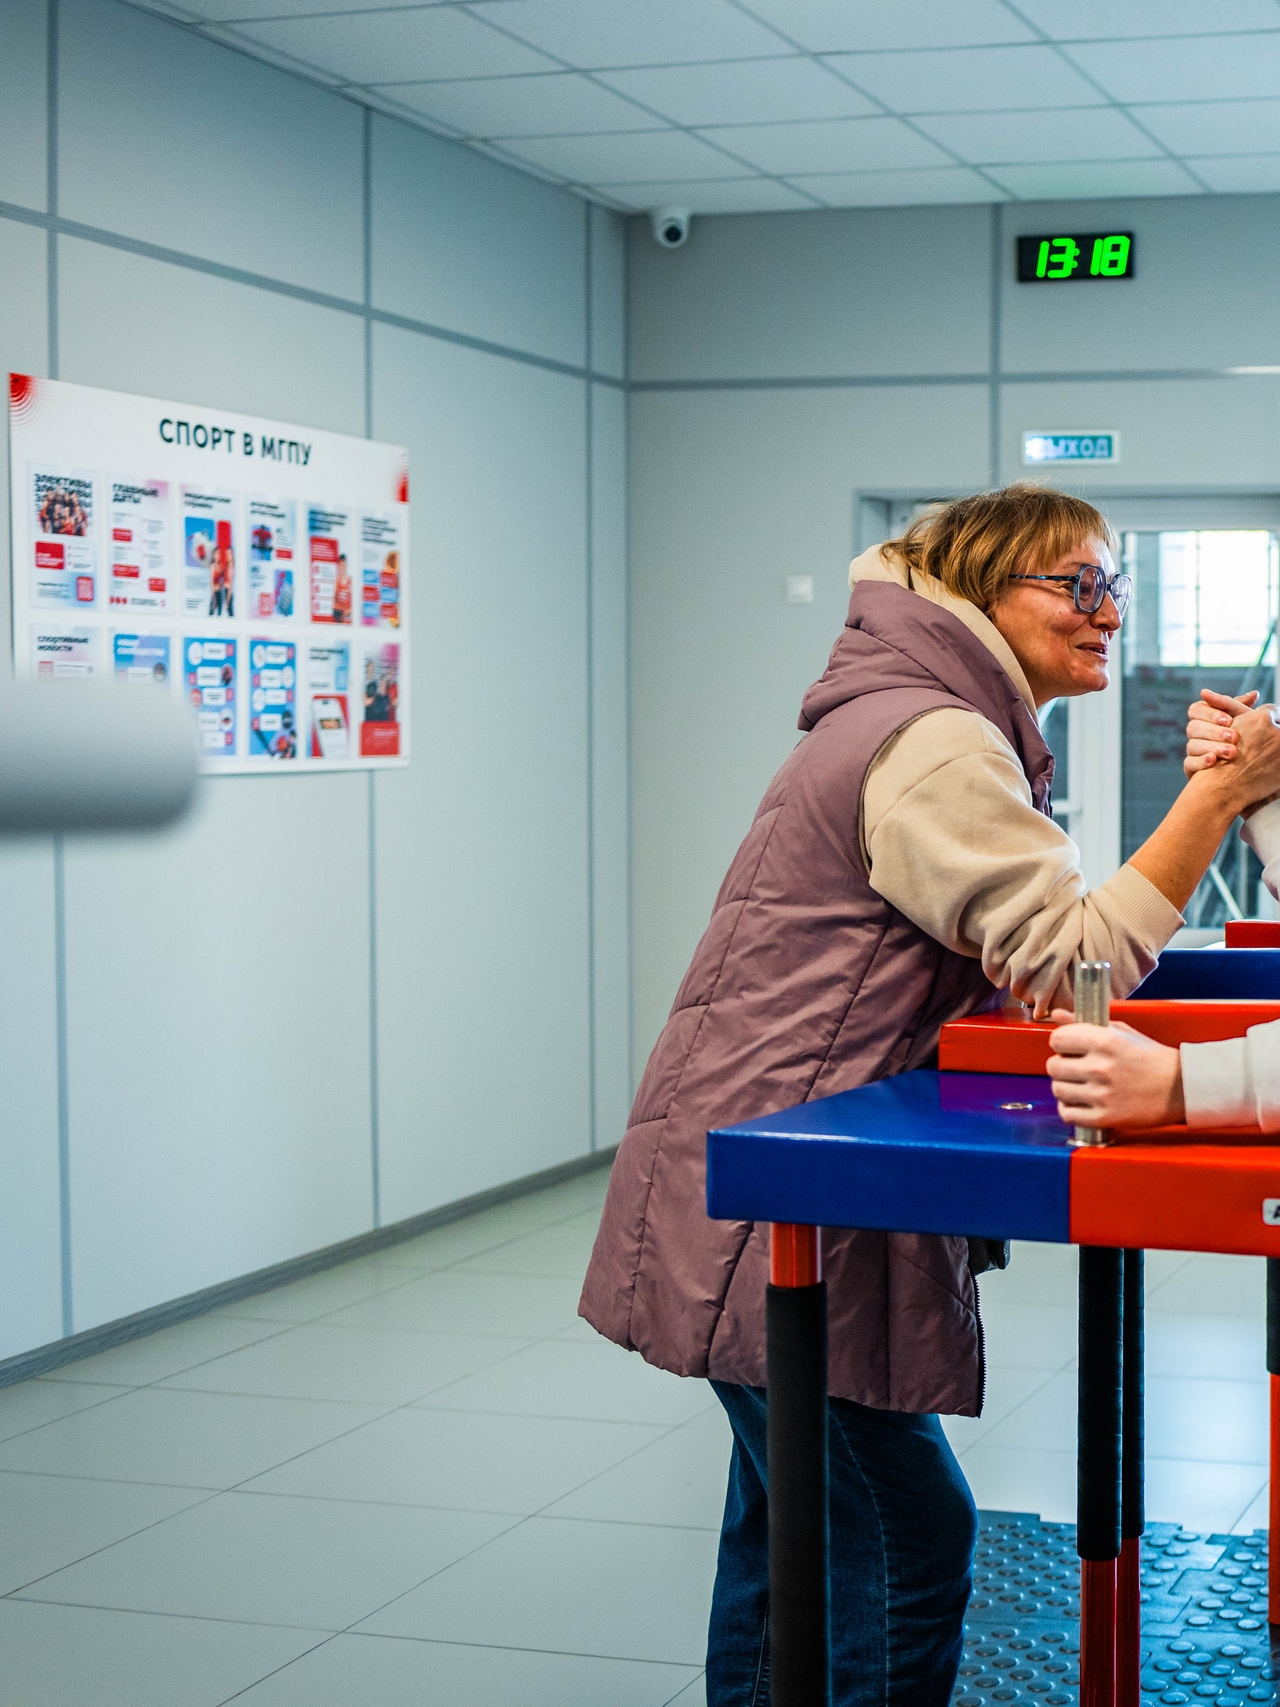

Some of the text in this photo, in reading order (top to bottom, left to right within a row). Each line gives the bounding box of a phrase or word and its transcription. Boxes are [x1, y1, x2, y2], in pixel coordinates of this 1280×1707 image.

[159, 418, 313, 466] СПОРТ В МГПУ
